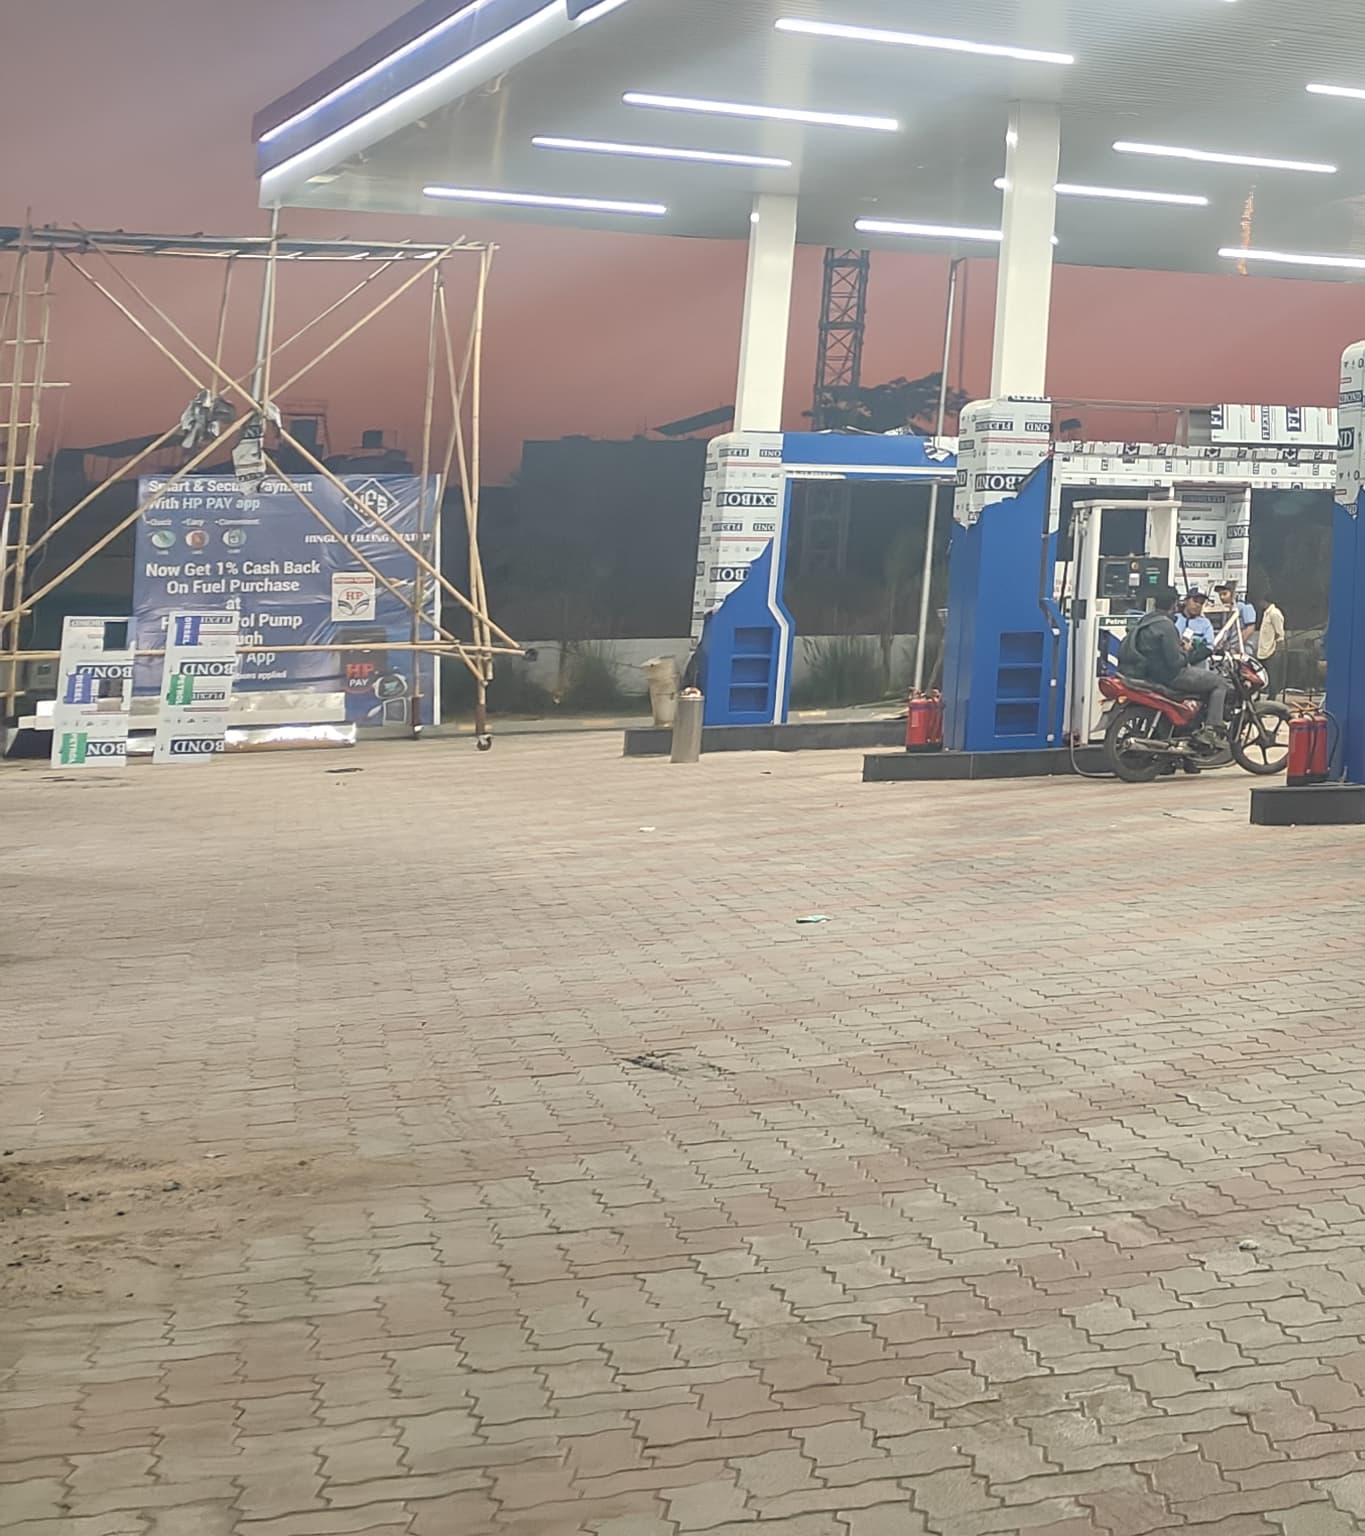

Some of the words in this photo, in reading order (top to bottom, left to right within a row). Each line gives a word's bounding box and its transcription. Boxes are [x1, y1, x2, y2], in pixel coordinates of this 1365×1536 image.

[192, 479, 204, 493] &
[207, 479, 242, 493] Secu
[149, 497, 180, 510] With
[182, 498, 204, 510] HP
[206, 497, 234, 510] PAY
[236, 499, 261, 513] app
[145, 563, 181, 578] Now
[184, 562, 212, 576] Get
[216, 561, 239, 576] 1%
[242, 560, 281, 576] Cash
[283, 560, 322, 575] Back
[166, 580, 190, 595] On
[192, 579, 226, 594] Fuel
[229, 578, 301, 593] Purchase
[345, 590, 364, 601] HP
[225, 596, 241, 611] at
[261, 615, 304, 630] Pump
[1105, 617, 1128, 627] Petrol
[247, 652, 276, 665] App
[349, 678, 370, 688] PAY
[87, 741, 127, 756] BON
